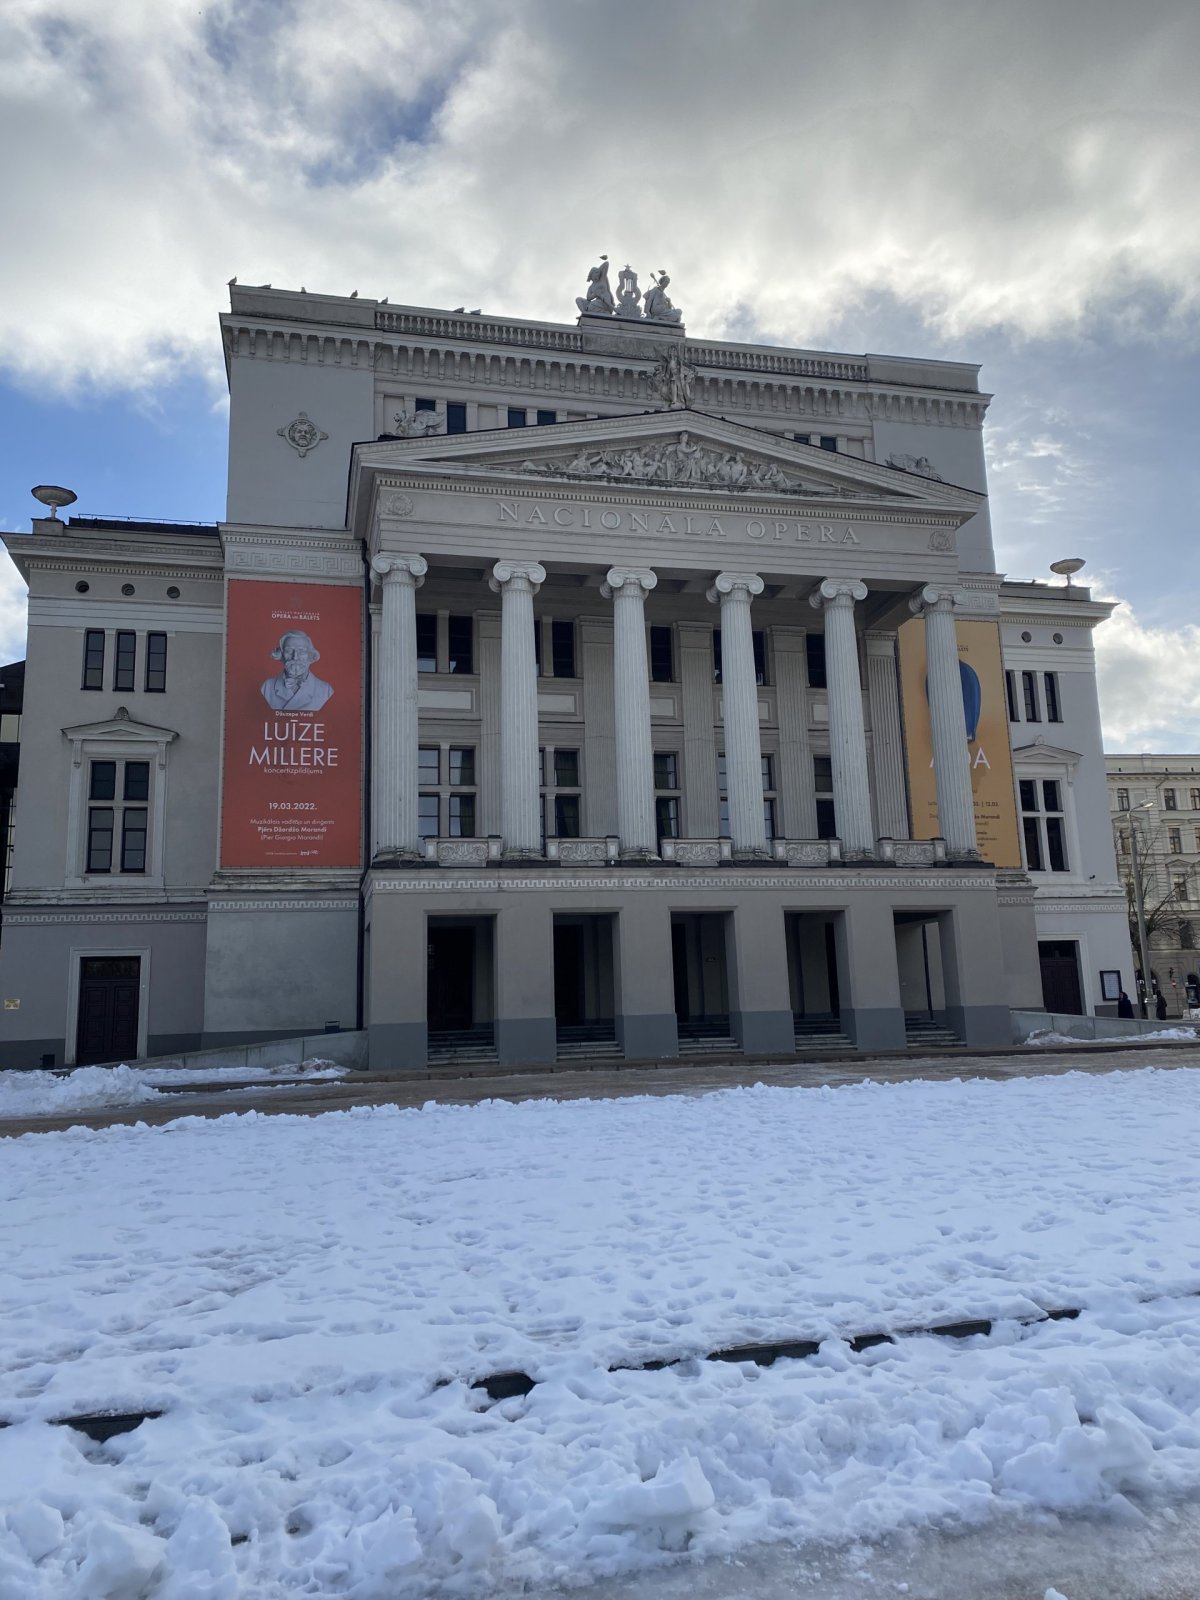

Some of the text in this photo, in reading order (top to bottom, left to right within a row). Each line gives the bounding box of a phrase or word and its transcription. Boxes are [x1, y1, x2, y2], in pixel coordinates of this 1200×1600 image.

[498, 502, 860, 544] NACIONĀLĀ OPERA
[264, 719, 325, 742] LUĪZE
[249, 745, 338, 766] MILLERE
[269, 802, 318, 810] 19.03.2022.
